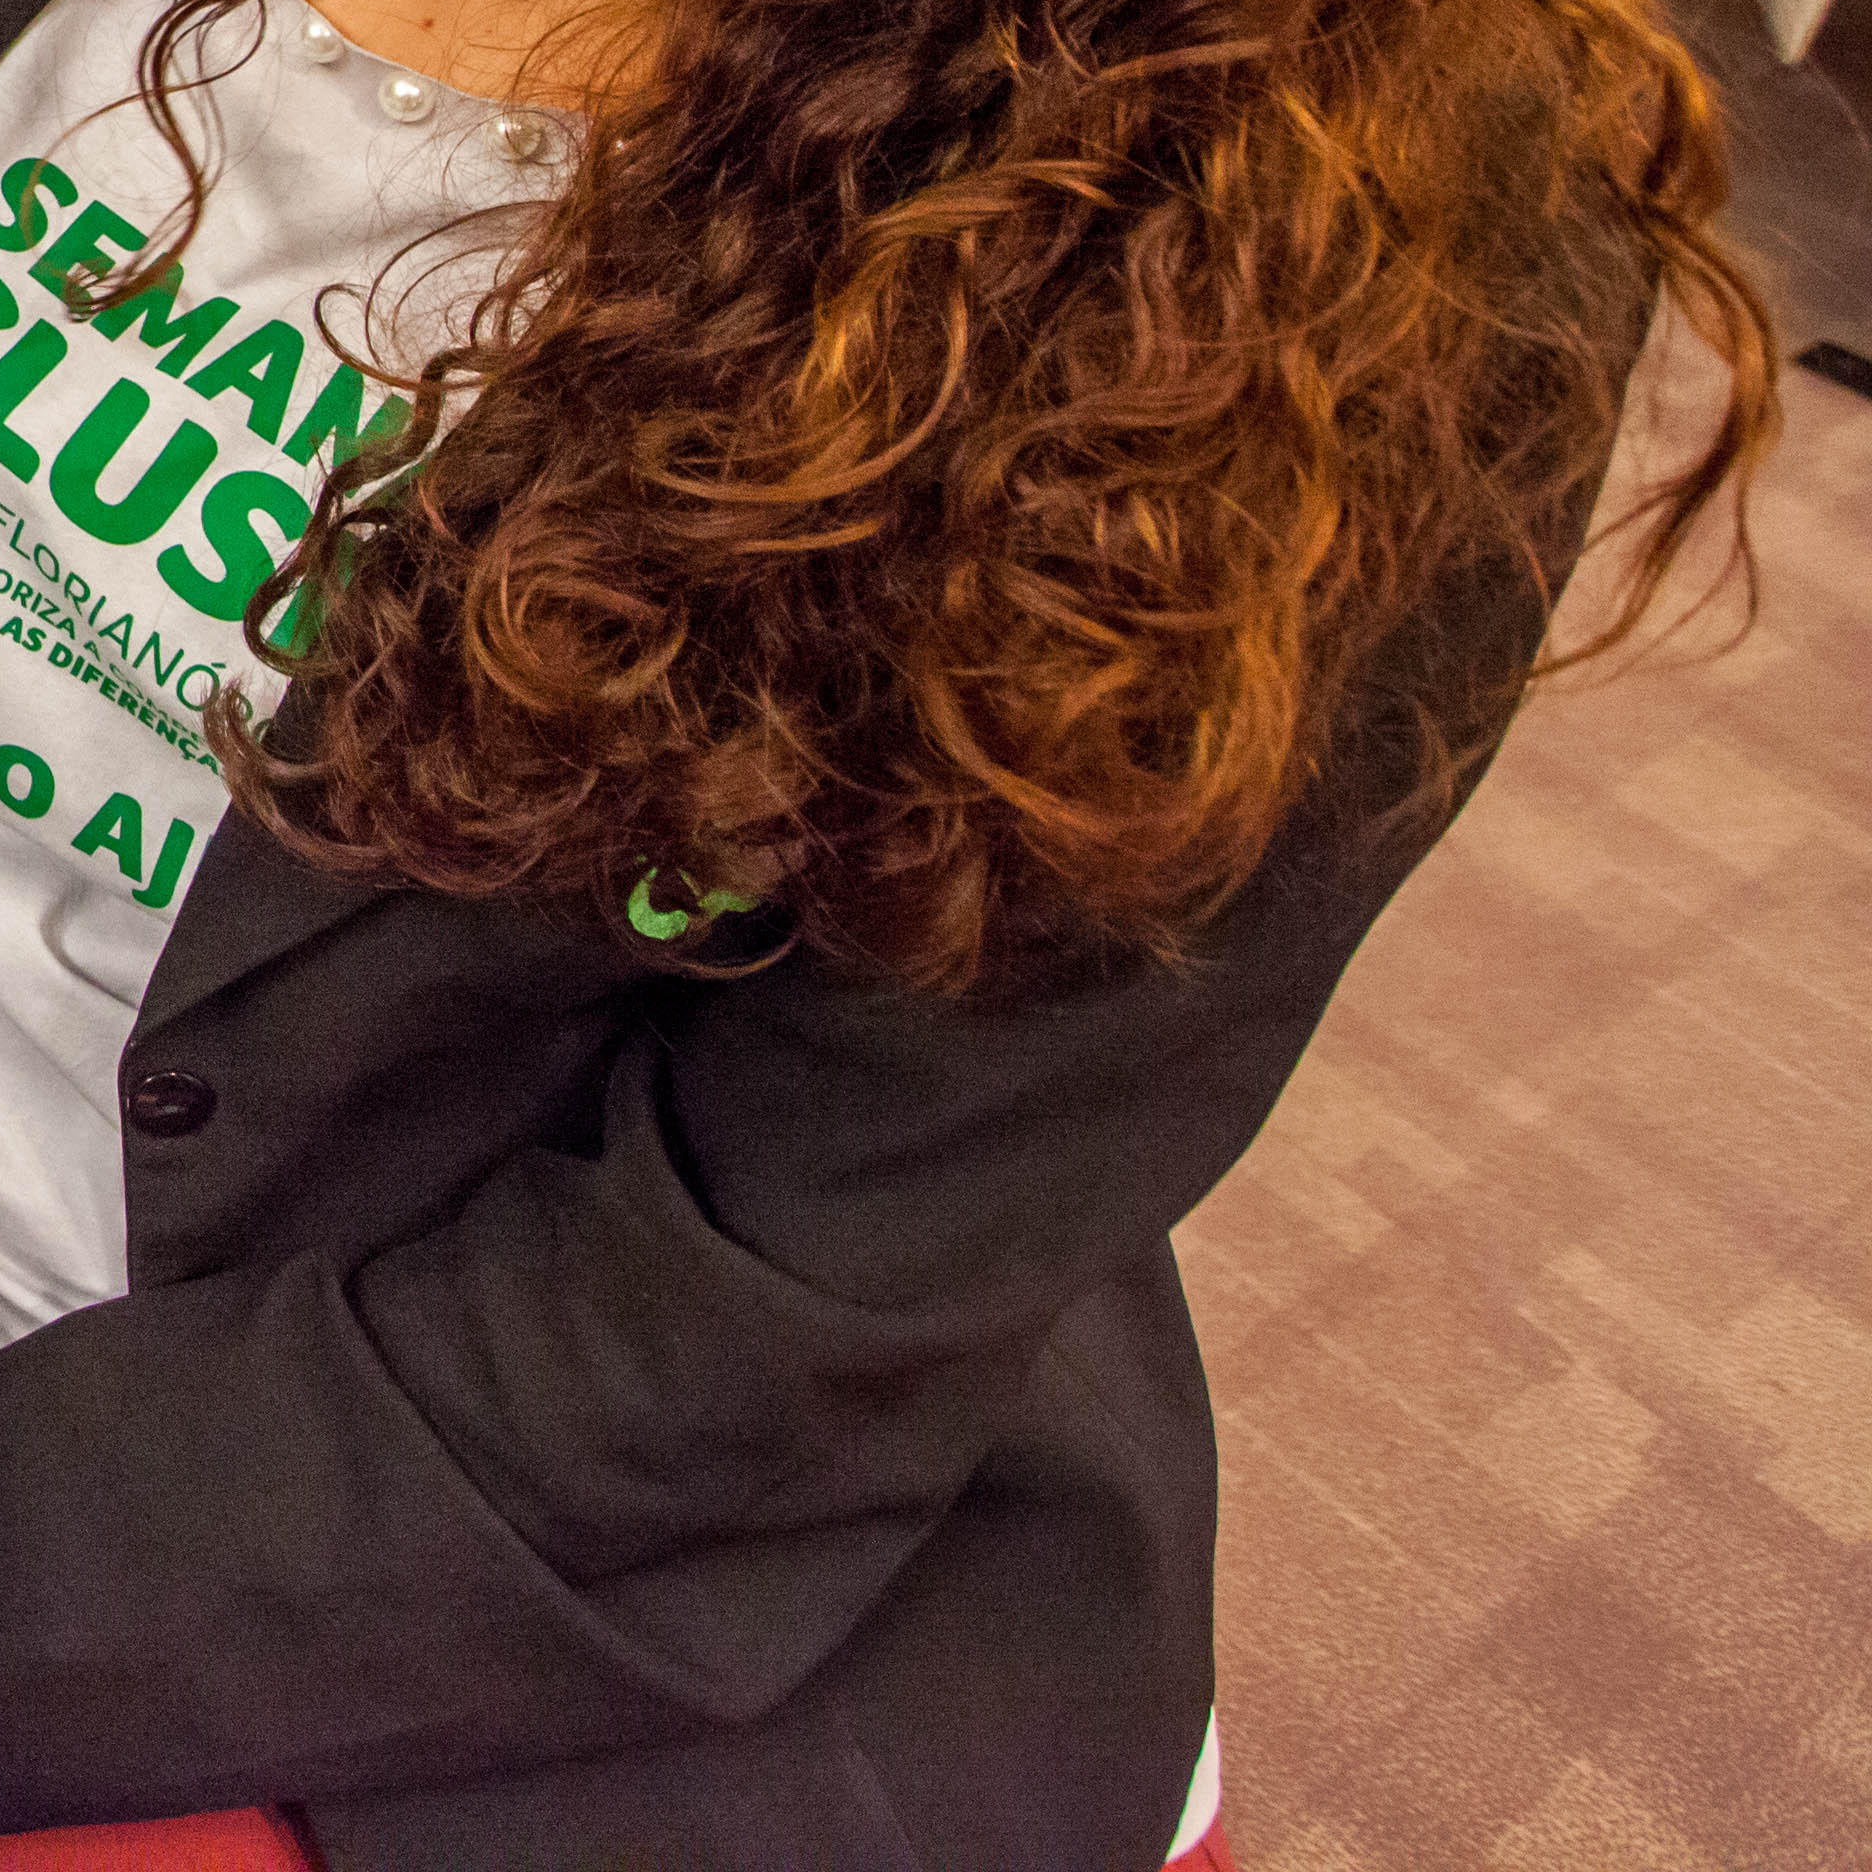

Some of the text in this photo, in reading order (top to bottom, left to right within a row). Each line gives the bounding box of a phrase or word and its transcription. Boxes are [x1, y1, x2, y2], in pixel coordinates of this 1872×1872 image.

[47, 641, 222, 777] DIFERENÇA
[83, 640, 103, 663] A
[70, 791, 202, 910] AJ
